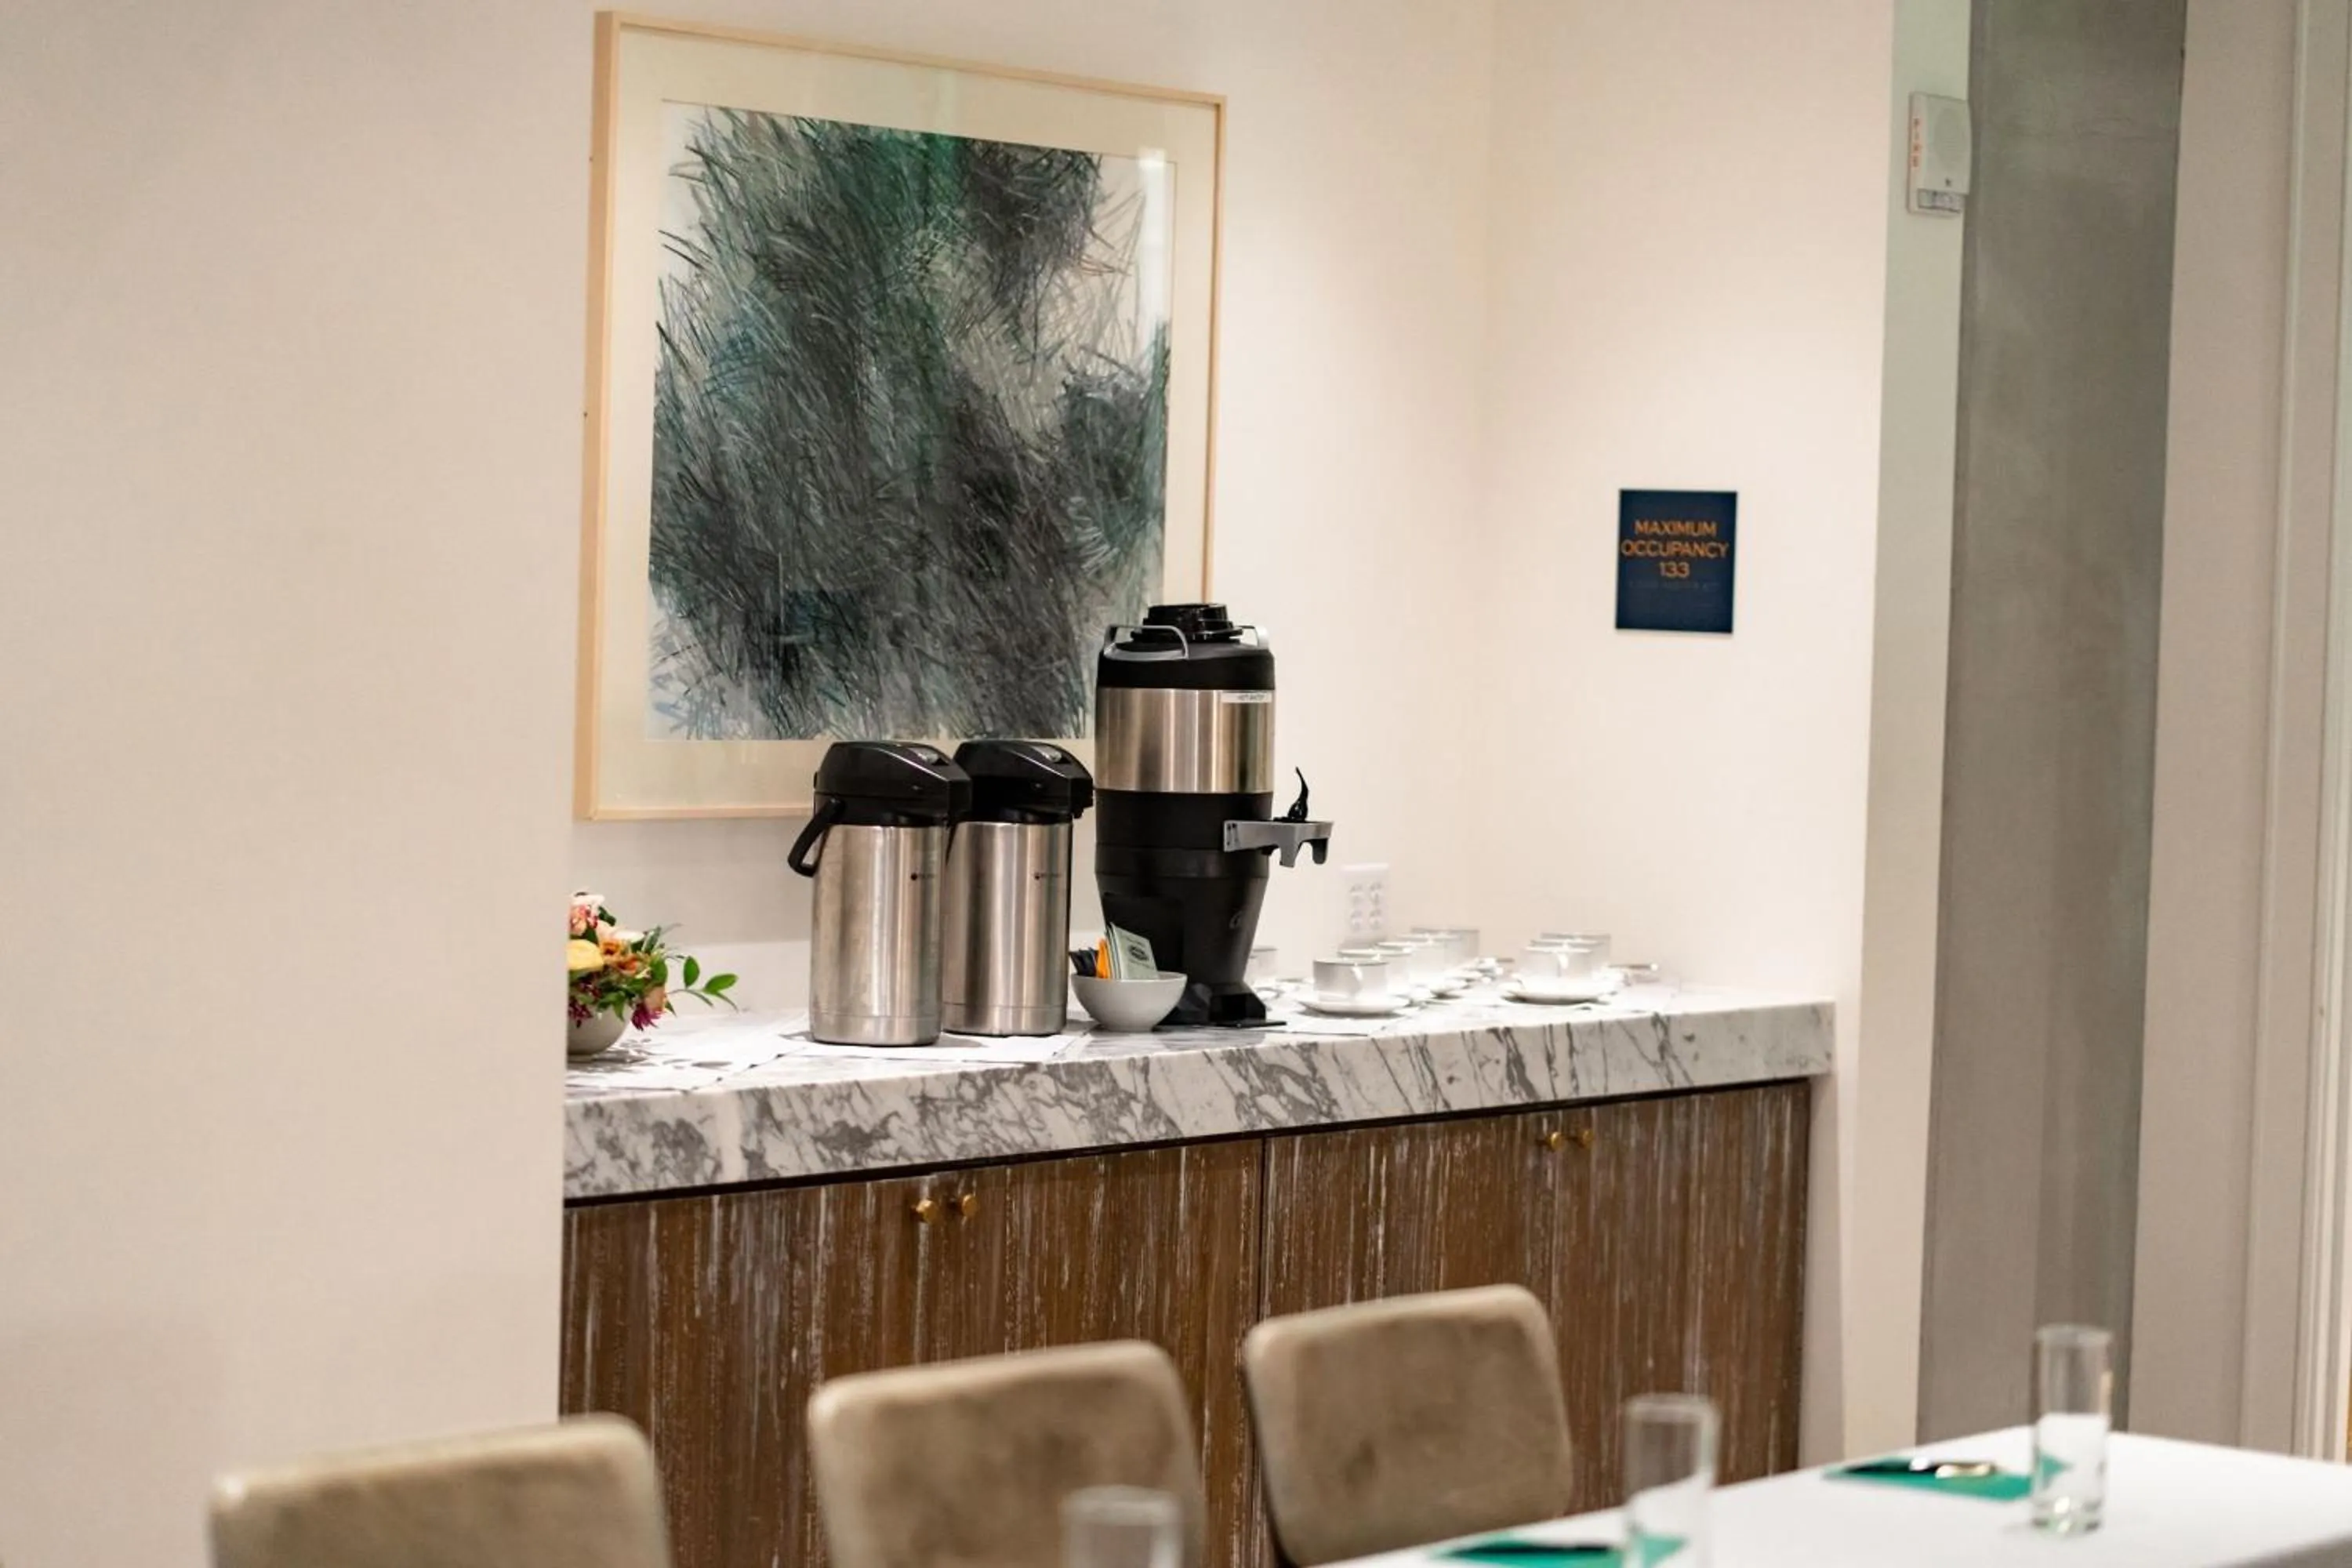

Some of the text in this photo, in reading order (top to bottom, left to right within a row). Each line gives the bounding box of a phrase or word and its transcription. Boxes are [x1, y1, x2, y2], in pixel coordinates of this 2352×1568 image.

[1635, 519, 1717, 536] MAXIMUM
[1621, 539, 1729, 558] OCCUPANCY
[1660, 561, 1690, 578] 133
